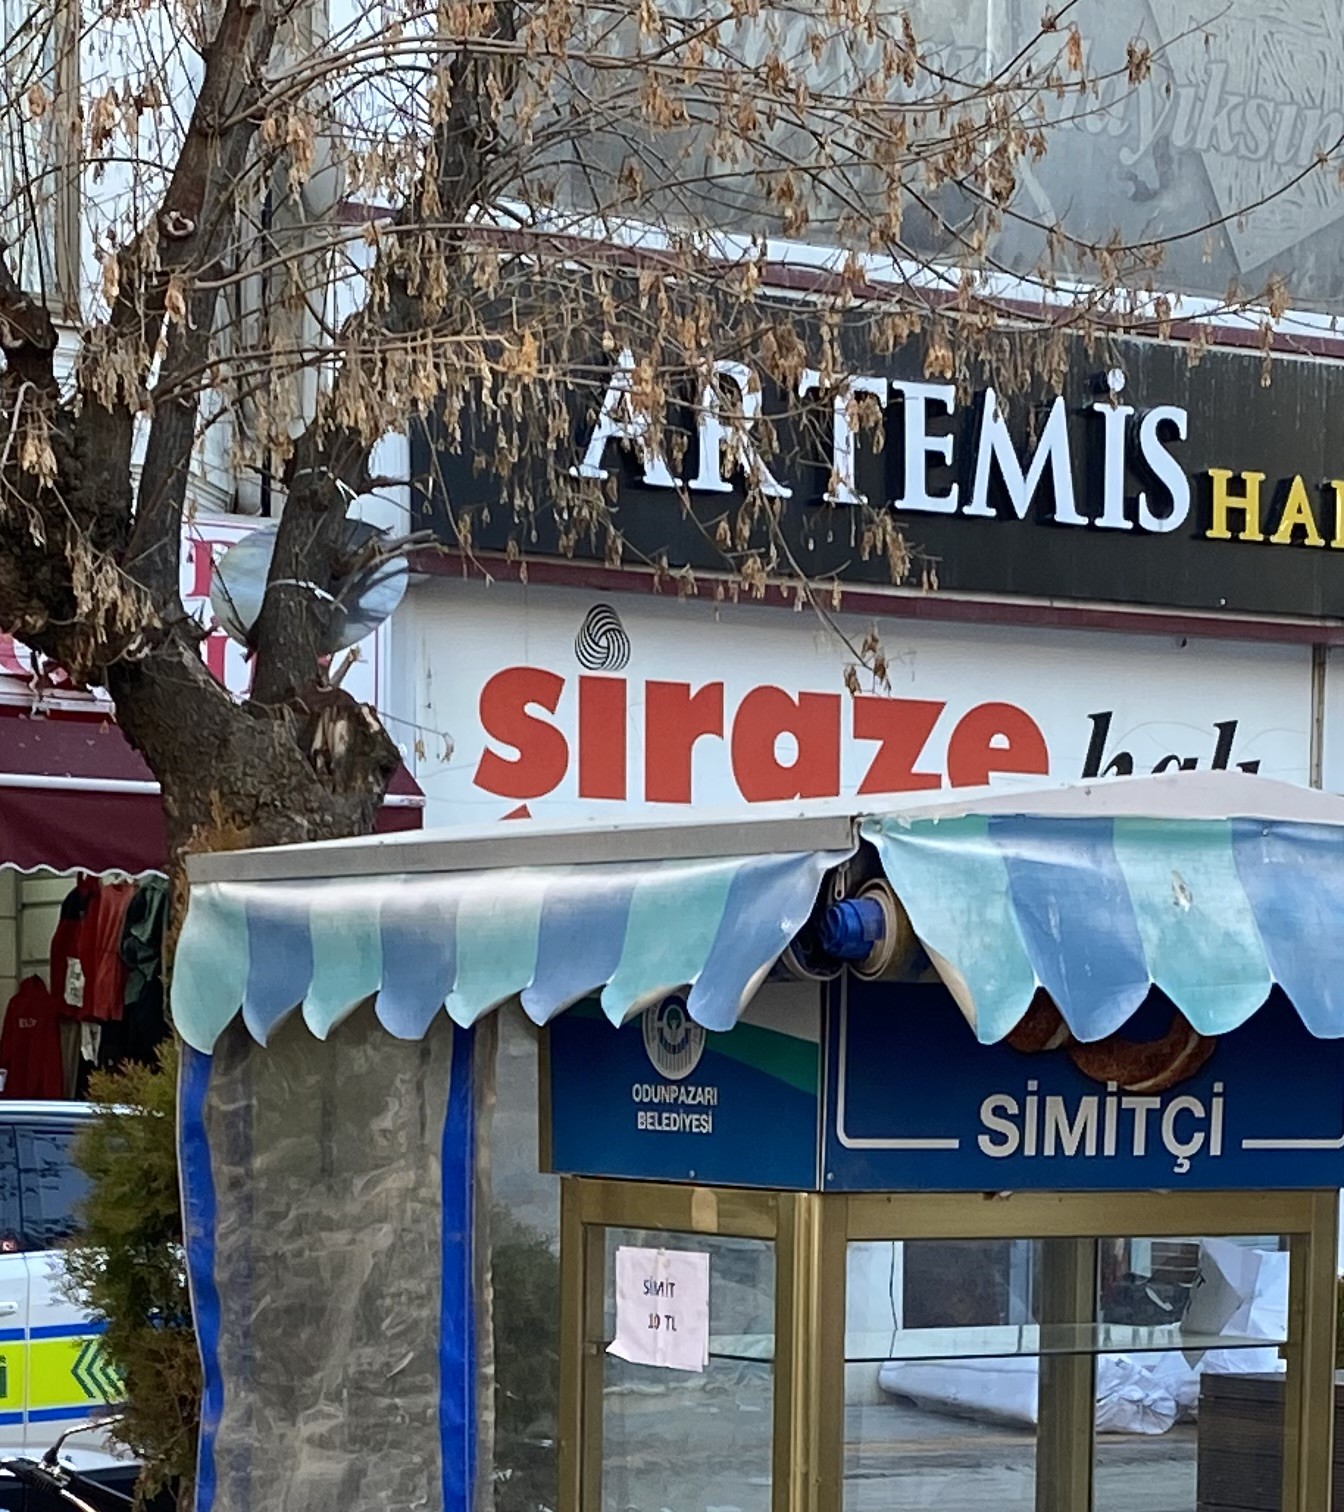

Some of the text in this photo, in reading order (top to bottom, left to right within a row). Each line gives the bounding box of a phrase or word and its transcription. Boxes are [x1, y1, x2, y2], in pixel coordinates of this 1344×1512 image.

[570, 348, 1190, 533] ARTEMİS
[632, 1084, 718, 1105] ODUNPAZARI
[637, 1109, 713, 1133] BELEDİYESİ
[977, 1080, 1226, 1174] SİMİTÇİ
[643, 1275, 676, 1298] SİMİT
[648, 1313, 677, 1332] 10 TL
